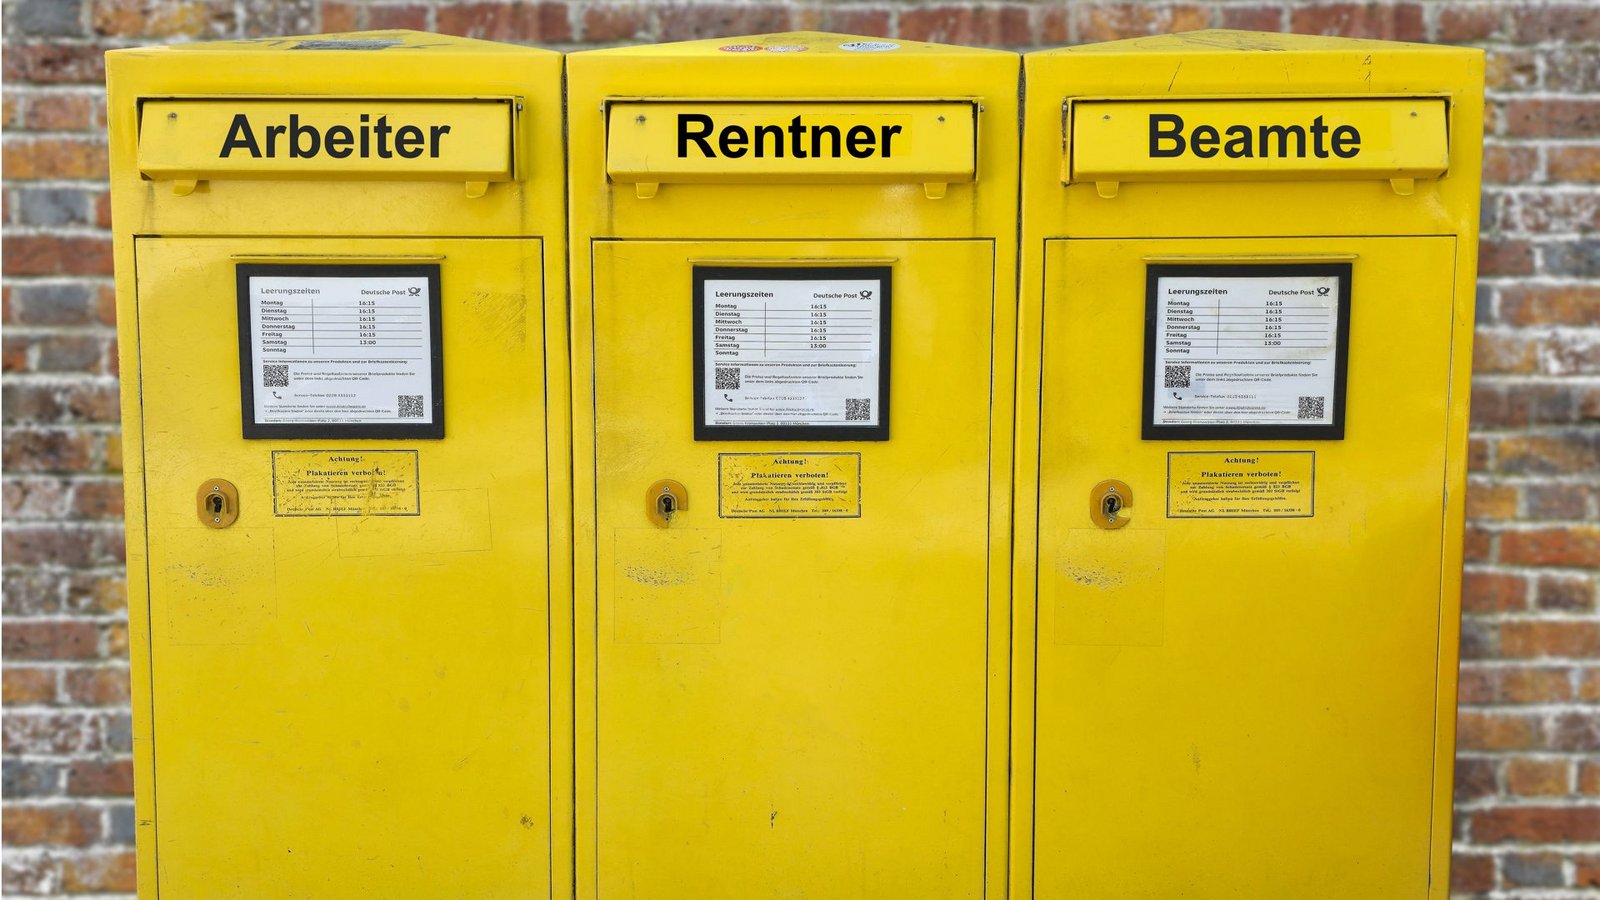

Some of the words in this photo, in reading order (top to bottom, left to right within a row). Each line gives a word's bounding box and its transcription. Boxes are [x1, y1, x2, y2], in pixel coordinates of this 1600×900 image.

[220, 114, 451, 158] Arbeiter
[677, 114, 903, 158] Rentner
[1149, 114, 1361, 158] Beamte
